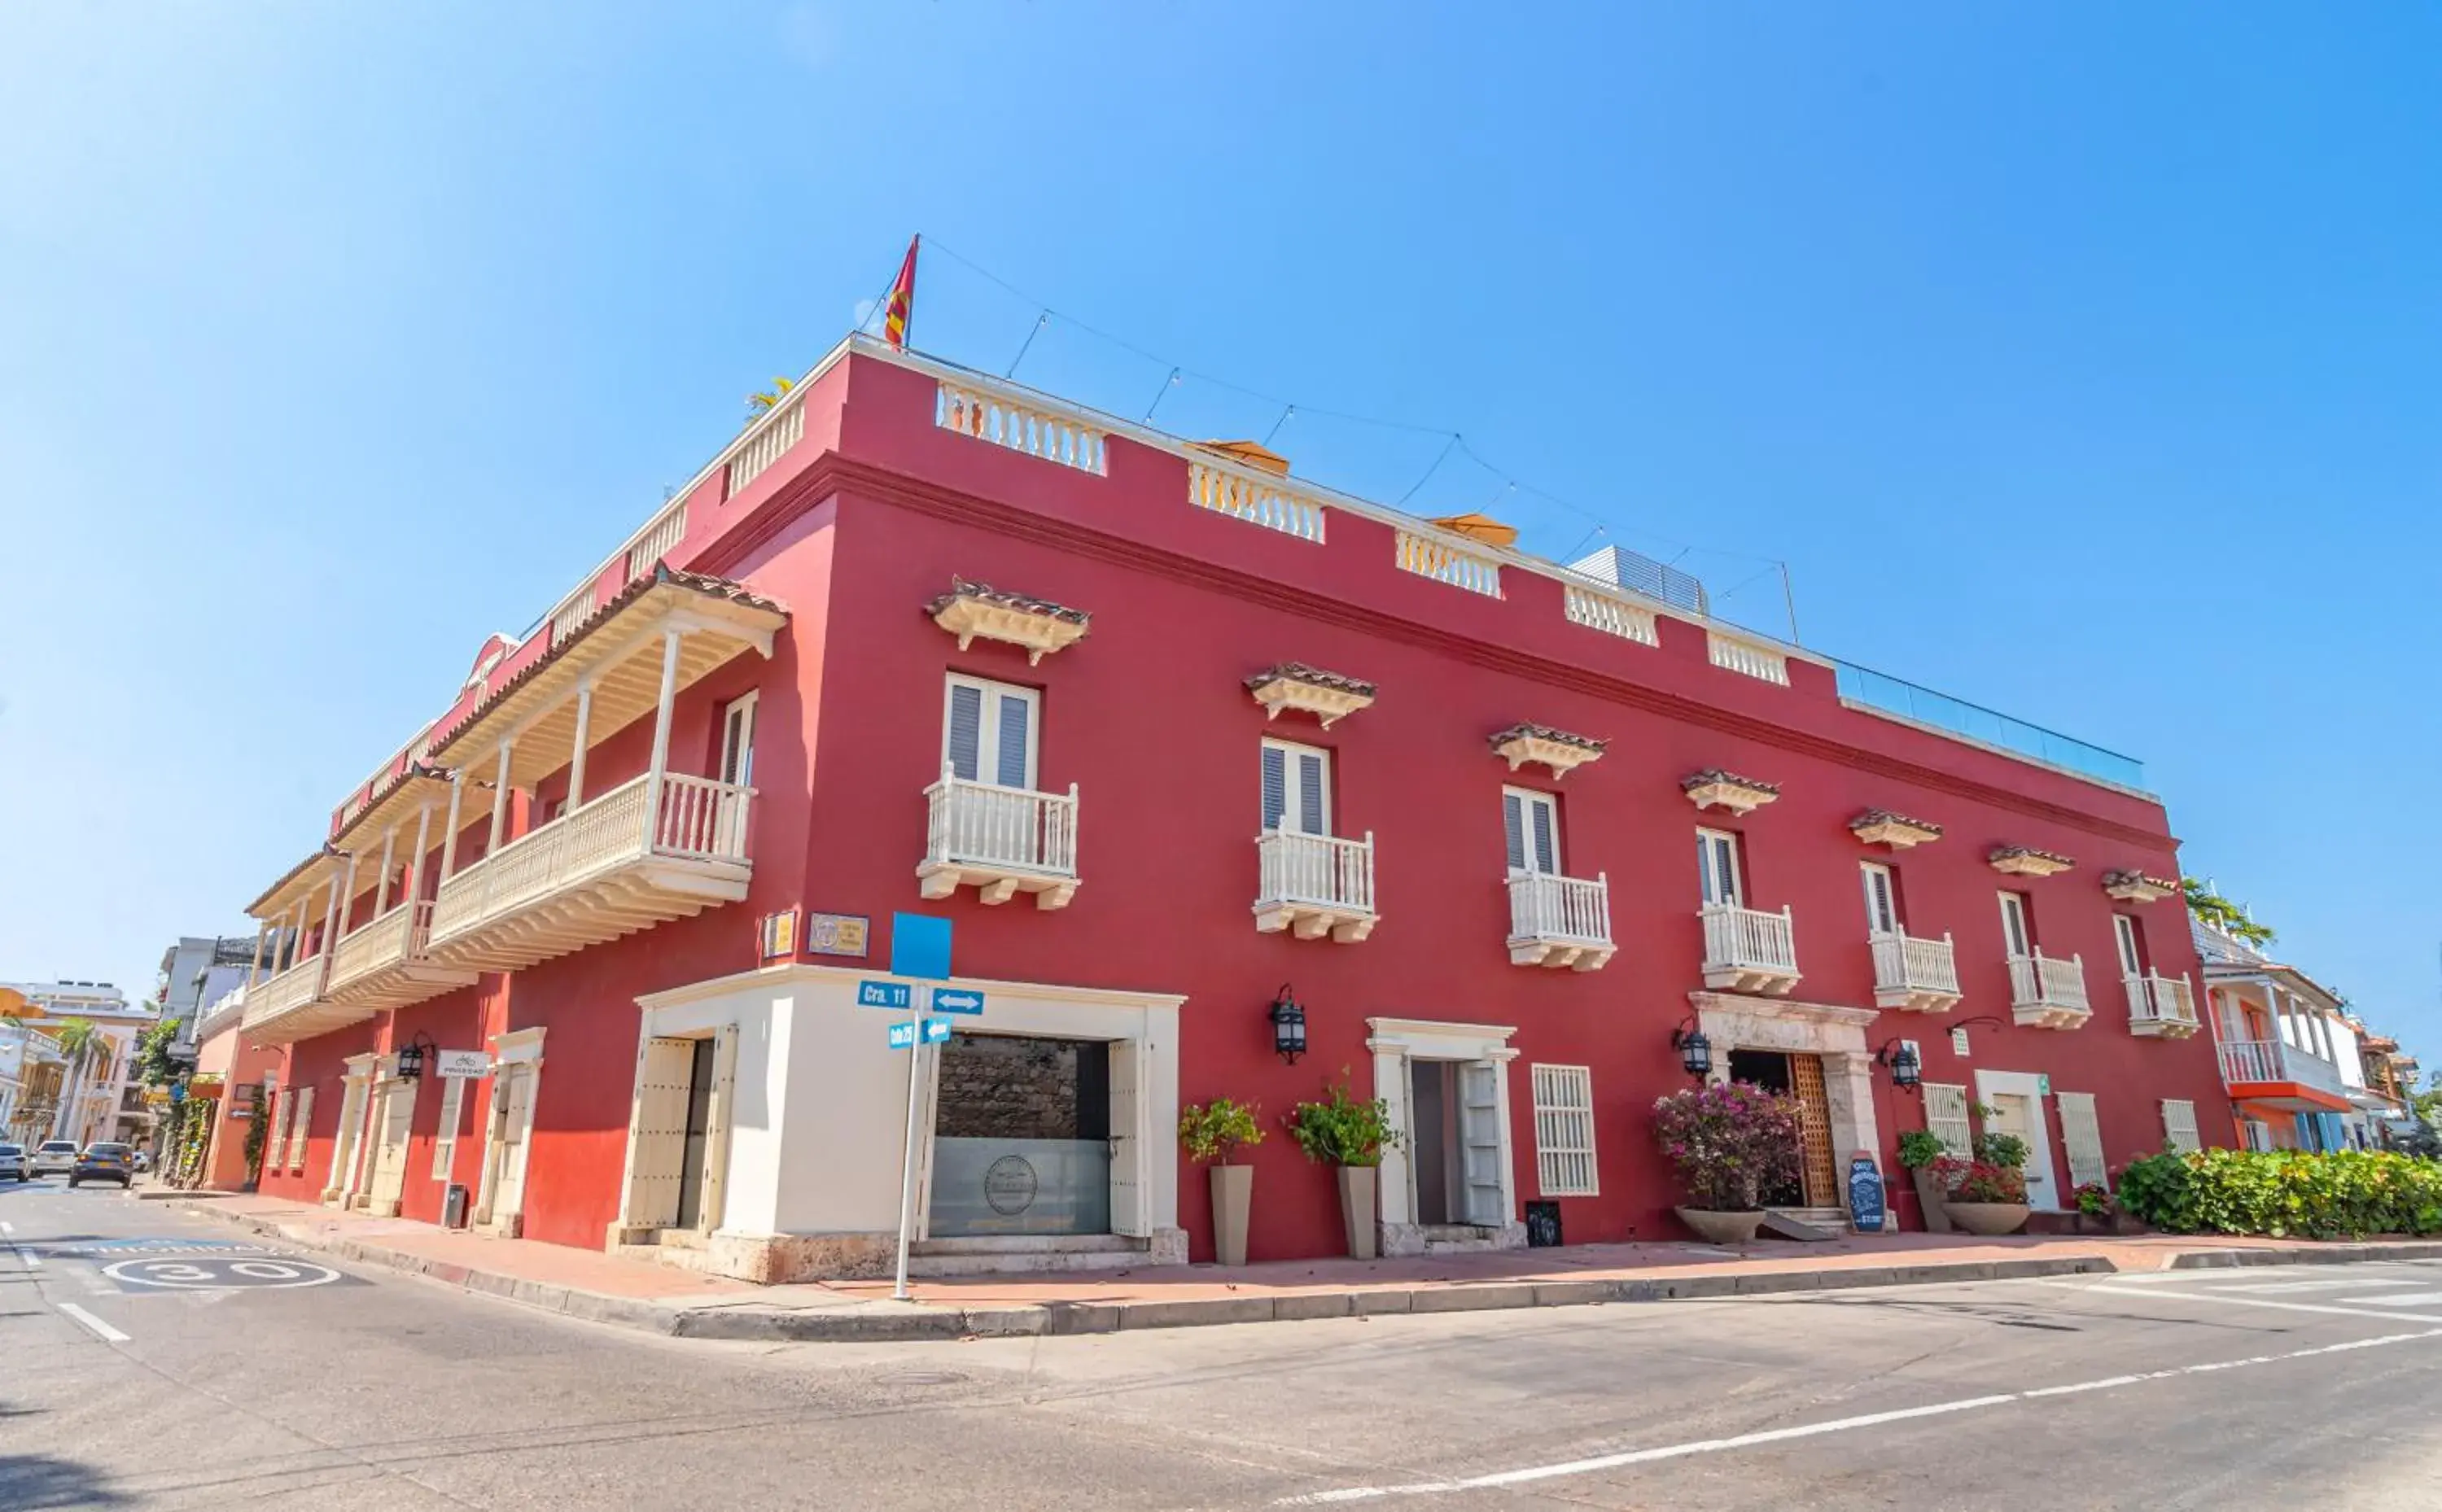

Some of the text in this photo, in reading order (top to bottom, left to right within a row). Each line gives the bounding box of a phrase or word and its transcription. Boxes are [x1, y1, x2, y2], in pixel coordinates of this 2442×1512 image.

[864, 985, 906, 1005] Cra. 11
[145, 1263, 300, 1280] 30
